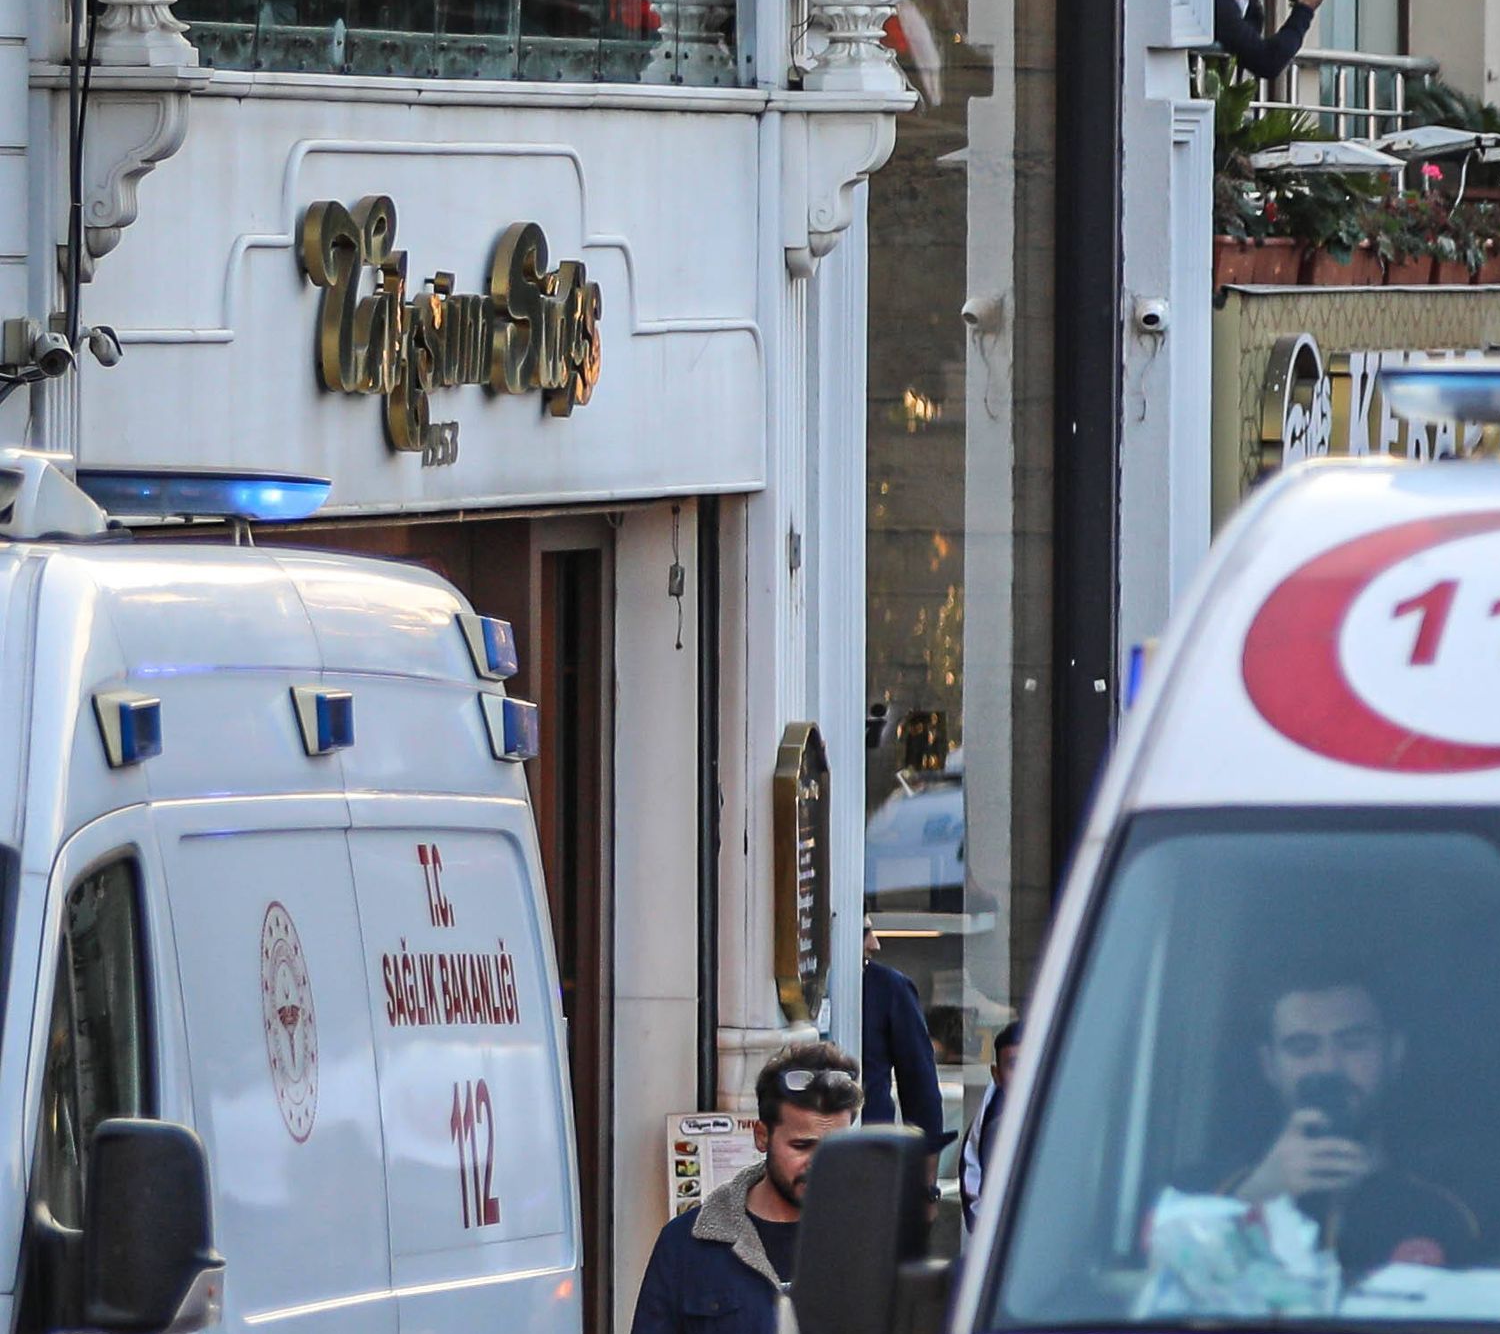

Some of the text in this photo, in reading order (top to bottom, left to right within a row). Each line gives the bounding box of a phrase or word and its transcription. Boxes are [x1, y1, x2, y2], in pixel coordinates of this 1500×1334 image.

[382, 936, 521, 1027] SAĞLIK BAKANLIĞI
[450, 1078, 501, 1230] 112
